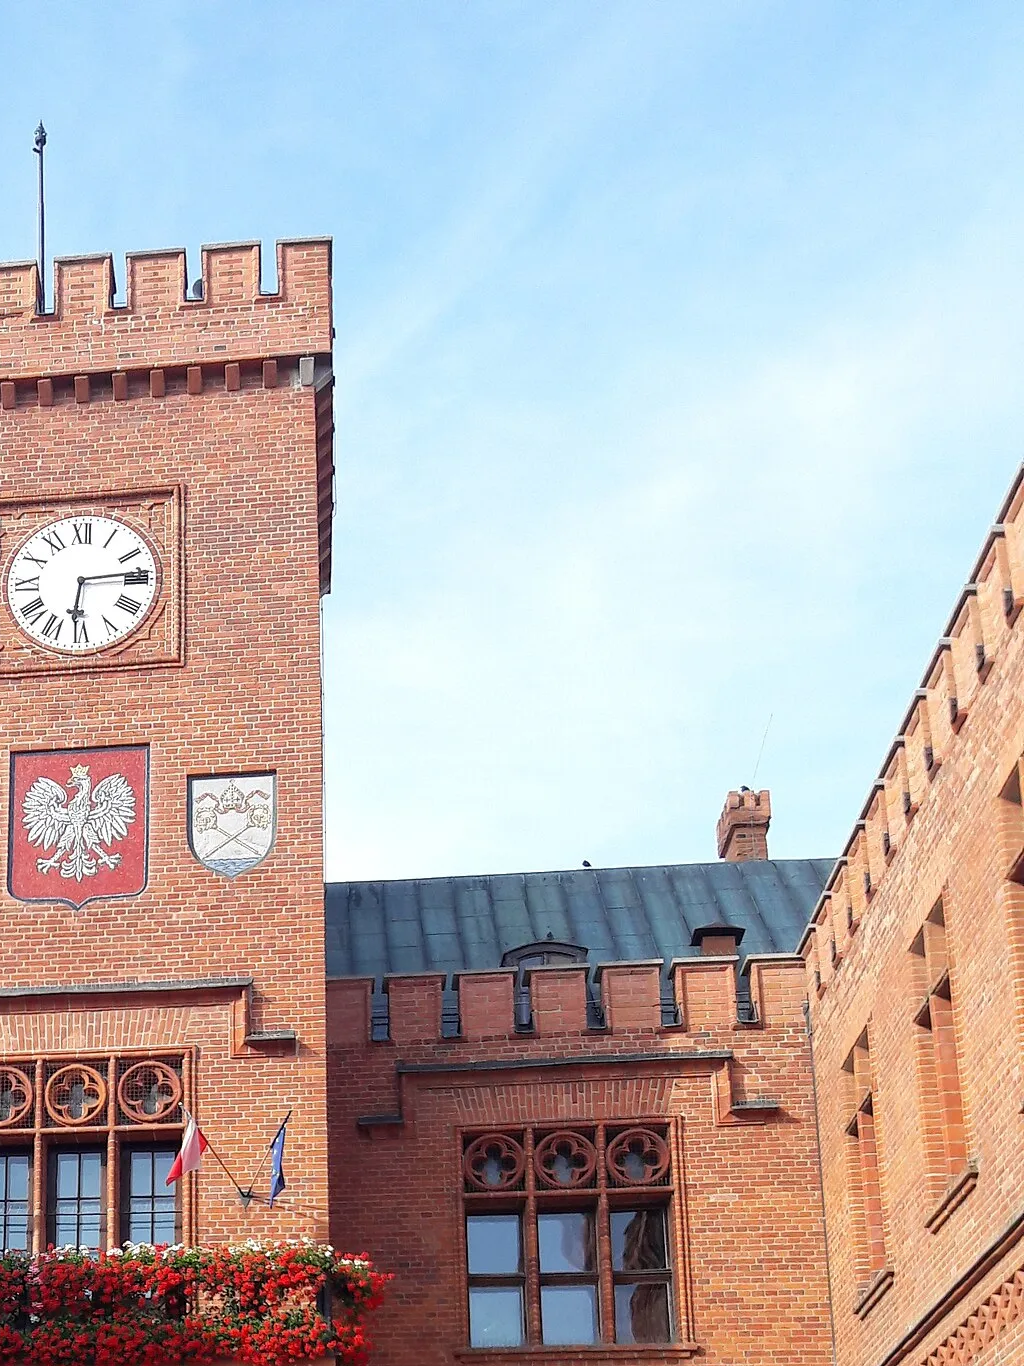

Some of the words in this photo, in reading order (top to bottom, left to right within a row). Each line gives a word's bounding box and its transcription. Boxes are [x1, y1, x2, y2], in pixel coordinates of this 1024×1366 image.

[41, 530, 67, 556] XI
[71, 523, 92, 545] XII
[103, 529, 119, 549] I
[22, 551, 48, 569] X
[118, 547, 142, 564] II
[15, 576, 40, 592] IX
[20, 596, 48, 626] VIII
[113, 593, 142, 616] IIII
[41, 613, 64, 641] VII
[101, 614, 119, 637] V
